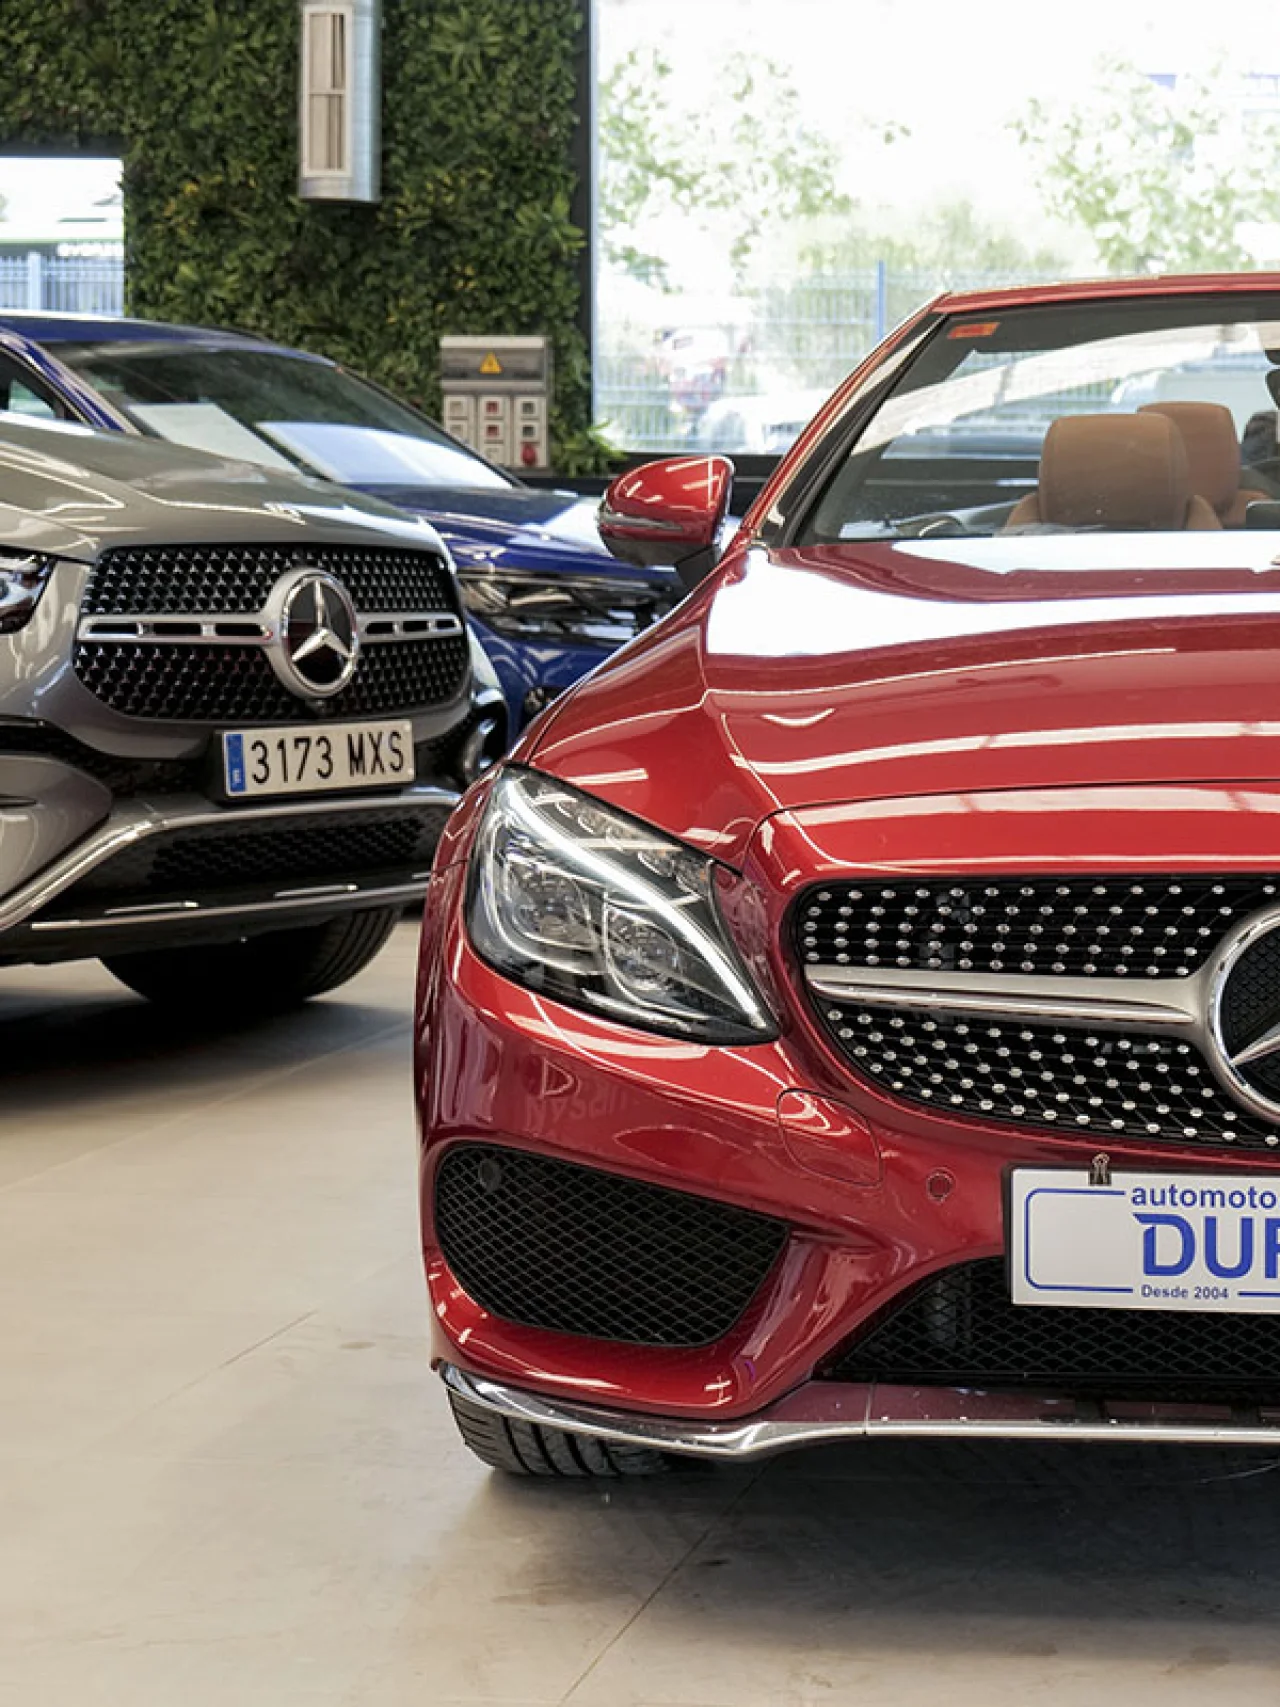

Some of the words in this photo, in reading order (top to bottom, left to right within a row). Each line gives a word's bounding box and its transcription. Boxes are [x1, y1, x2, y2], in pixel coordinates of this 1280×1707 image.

[251, 735, 333, 784] 3173
[347, 730, 404, 777] MXS
[1141, 1284, 1189, 1299] Desde
[1194, 1286, 1229, 1300] 2004
